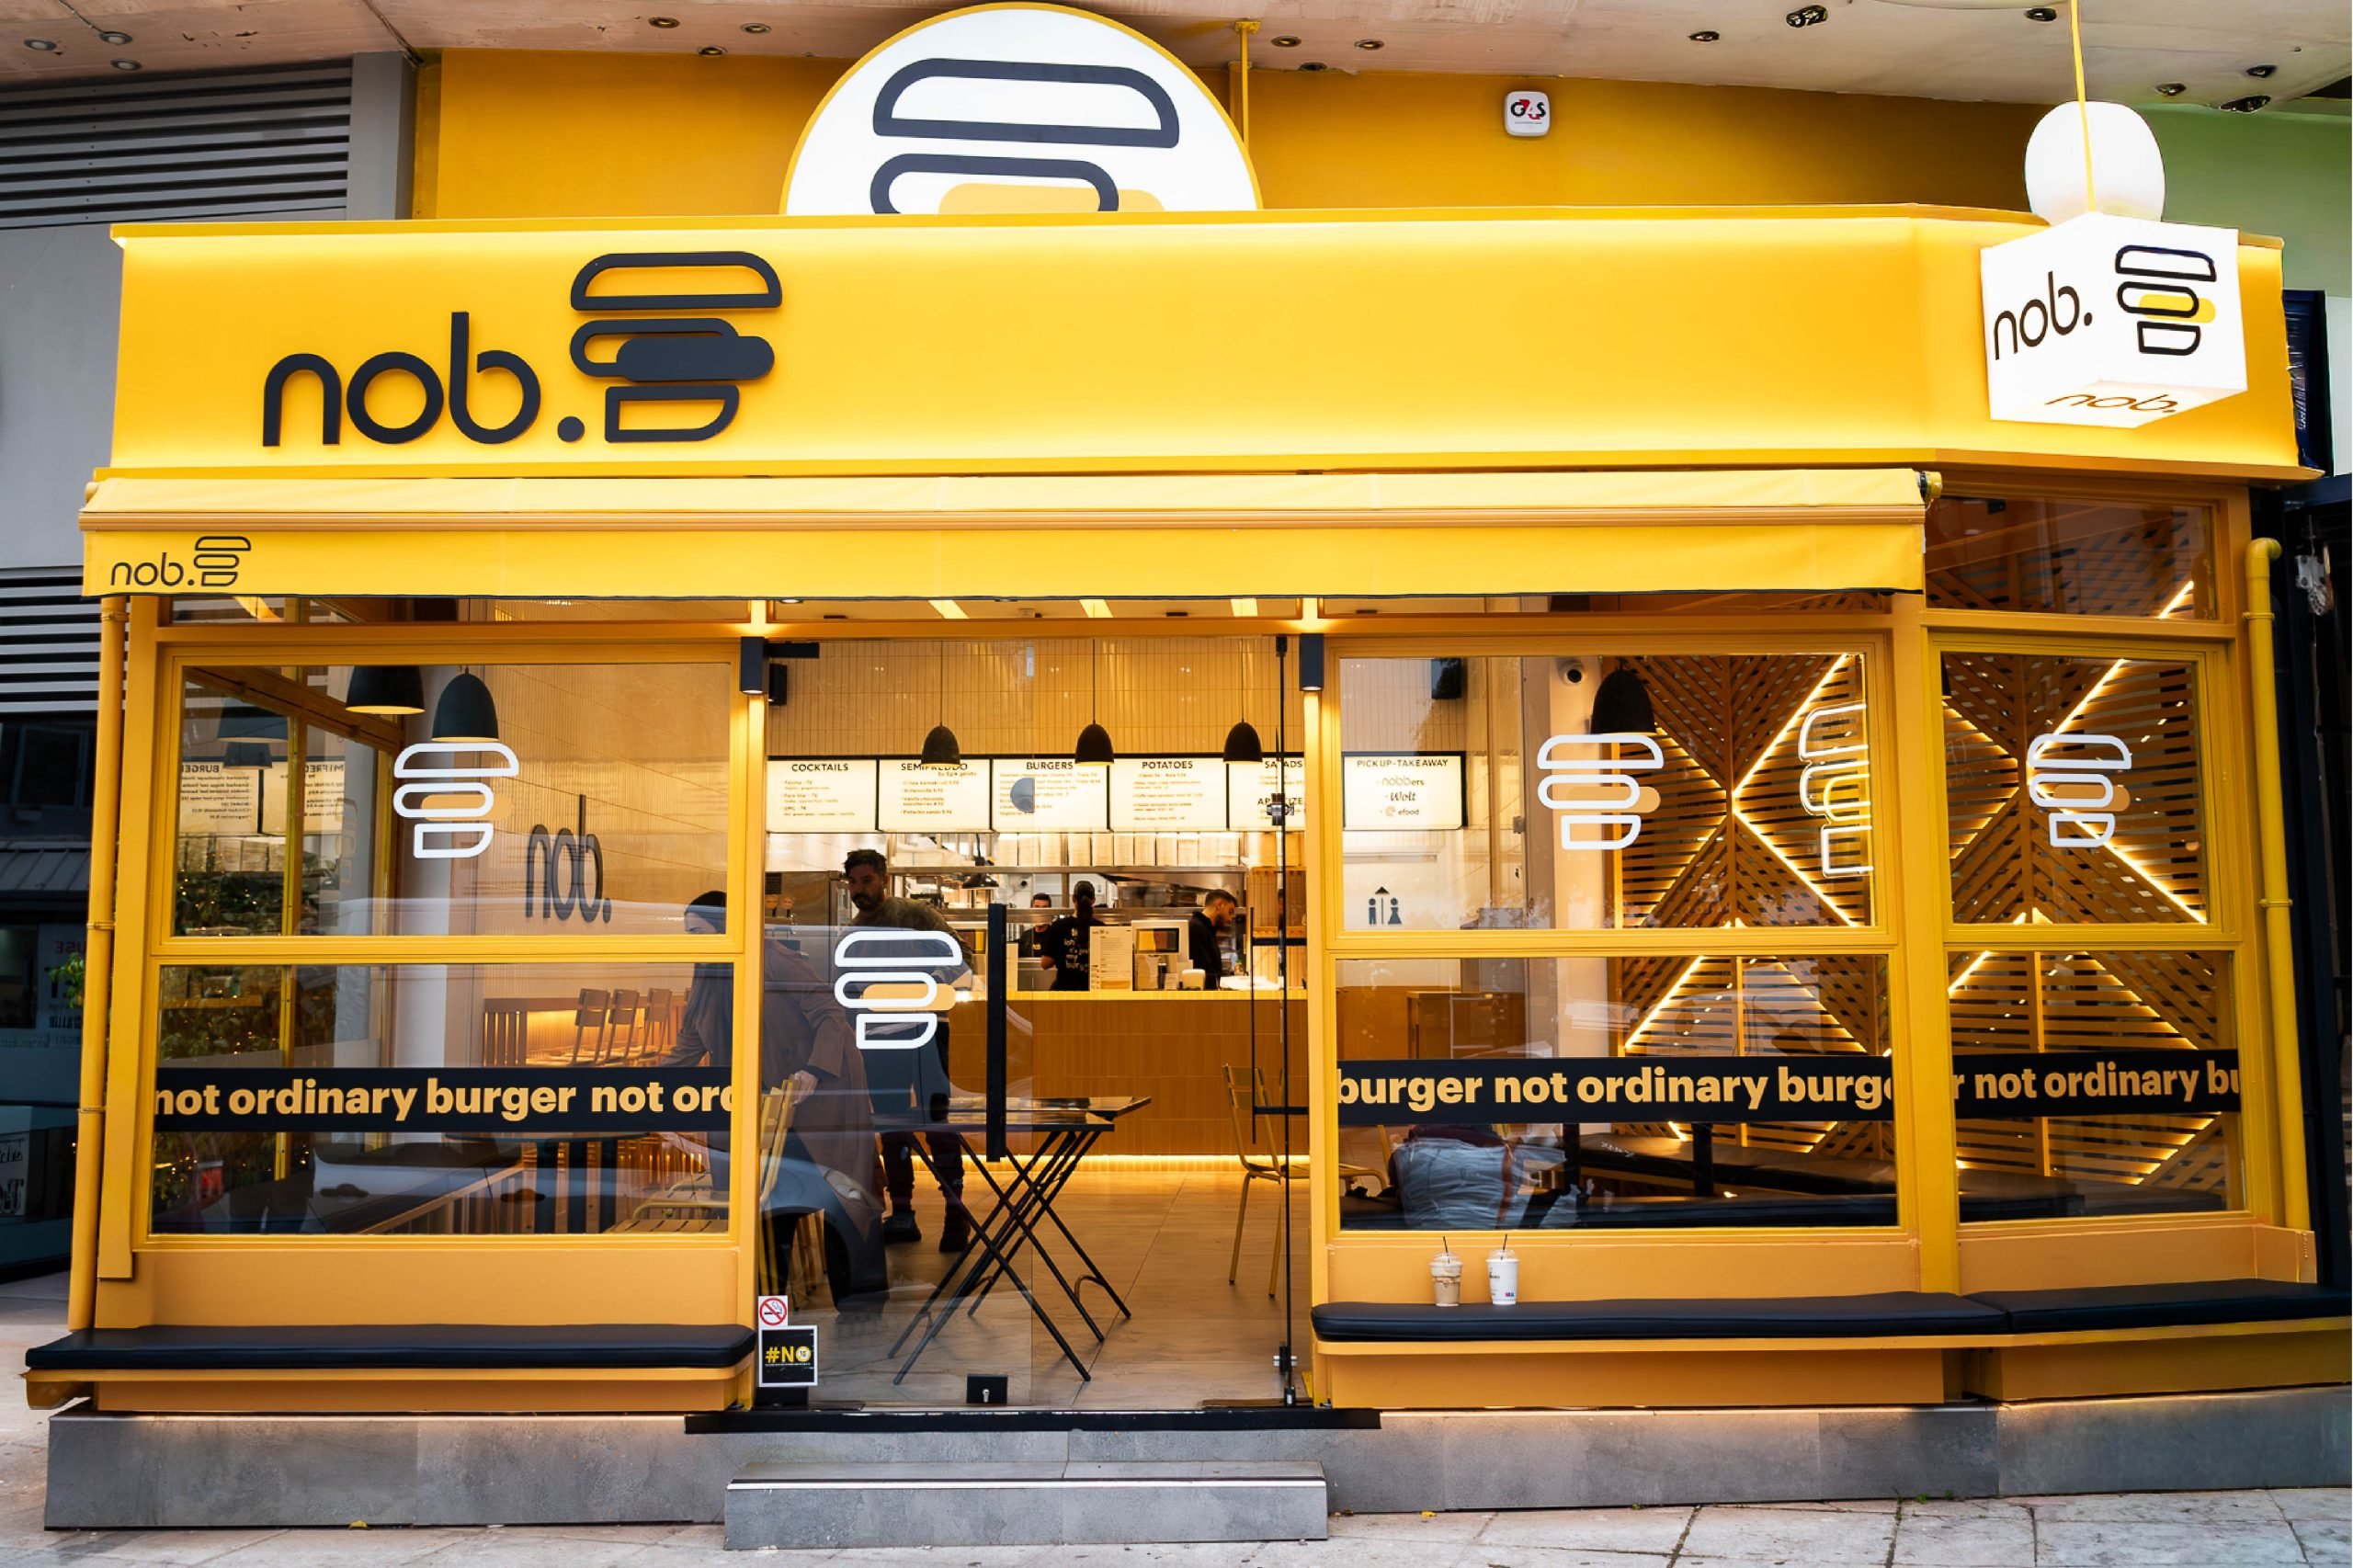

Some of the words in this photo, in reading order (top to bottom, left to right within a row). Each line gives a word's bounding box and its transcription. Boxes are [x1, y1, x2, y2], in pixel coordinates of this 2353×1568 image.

[1994, 270, 2093, 361] nob.
[263, 312, 585, 447] nob.
[2044, 393, 2179, 414] nob.
[110, 551, 195, 586] nob.
[791, 763, 849, 772] COCKTAILS
[1026, 761, 1074, 770] BURGERS
[1142, 760, 1193, 769] POTATOES
[1265, 760, 1303, 769] SAADS
[1381, 775, 1426, 787] nobbers
[1390, 791, 1417, 801] Wolt
[1398, 808, 1420, 816] efood
[526, 794, 611, 923] nob.
[1337, 1068, 1483, 1112] burger
[1495, 1074, 1568, 1104] not
[1576, 1066, 1768, 1109] ordinary
[1779, 1066, 1892, 1110] burg
[1974, 1069, 2037, 1099] not
[2044, 1061, 2200, 1102] ordinary
[154, 1085, 220, 1115] not
[229, 1078, 417, 1121] ordinary
[426, 1077, 576, 1121] burger
[591, 1083, 664, 1113] not
